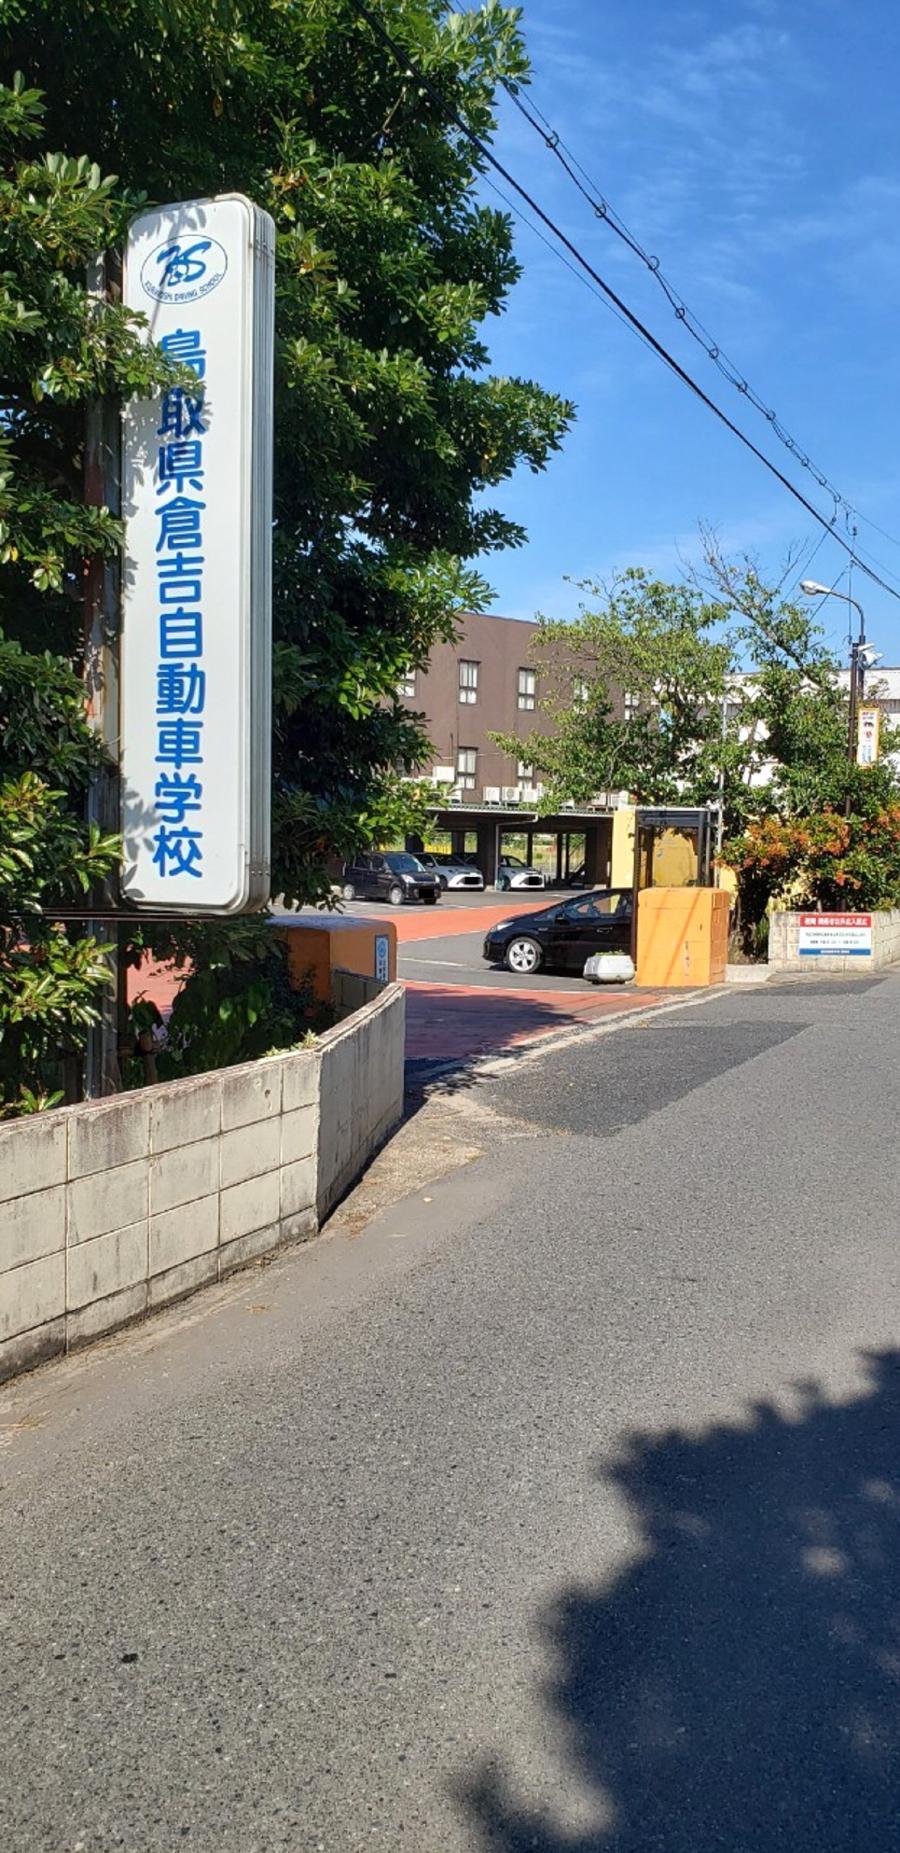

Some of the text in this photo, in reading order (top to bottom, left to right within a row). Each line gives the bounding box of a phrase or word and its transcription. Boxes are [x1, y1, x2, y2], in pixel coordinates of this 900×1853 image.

[174, 290, 198, 301] DRIVING
[199, 273, 222, 293] SCHOOL
[152, 328, 207, 878] 鳥取県倉吉自動車学校
